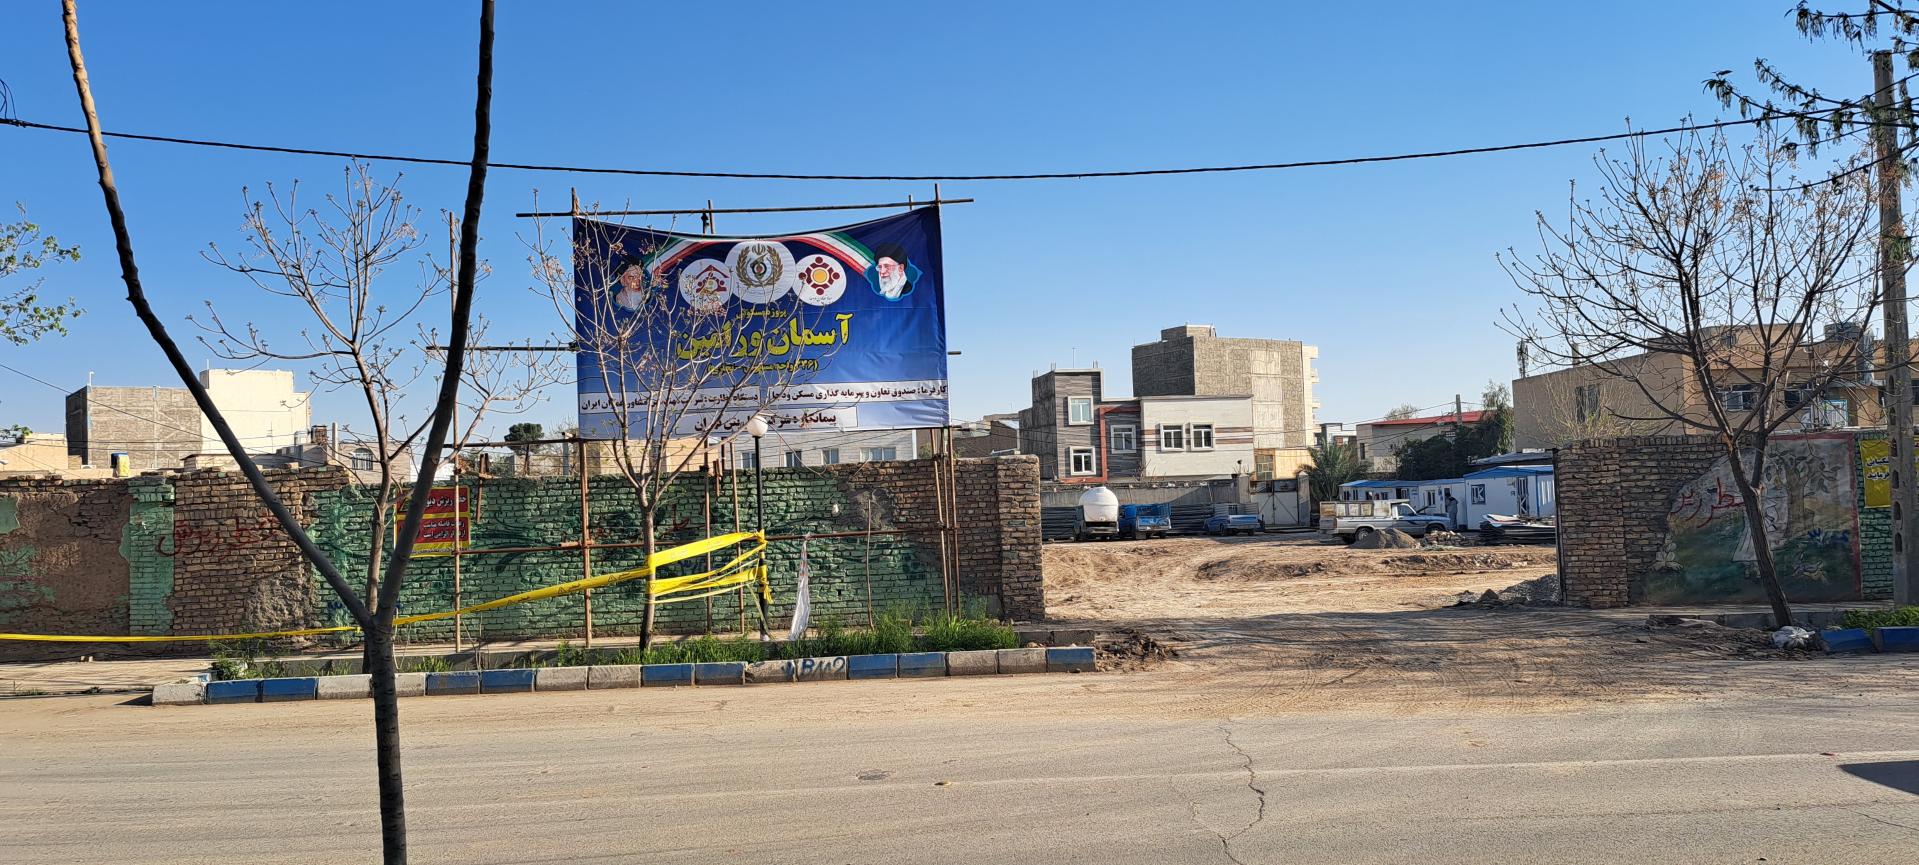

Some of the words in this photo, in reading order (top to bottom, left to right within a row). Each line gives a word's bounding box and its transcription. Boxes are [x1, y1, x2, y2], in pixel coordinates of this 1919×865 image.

[675, 320, 763, 360] ورامین
[766, 313, 854, 356] آسمان
[792, 389, 814, 400] مسکن
[840, 389, 865, 399] سرمایه
[870, 387, 890, 398] تعاون
[891, 387, 916, 397] صندوق
[580, 399, 601, 410] ایران
